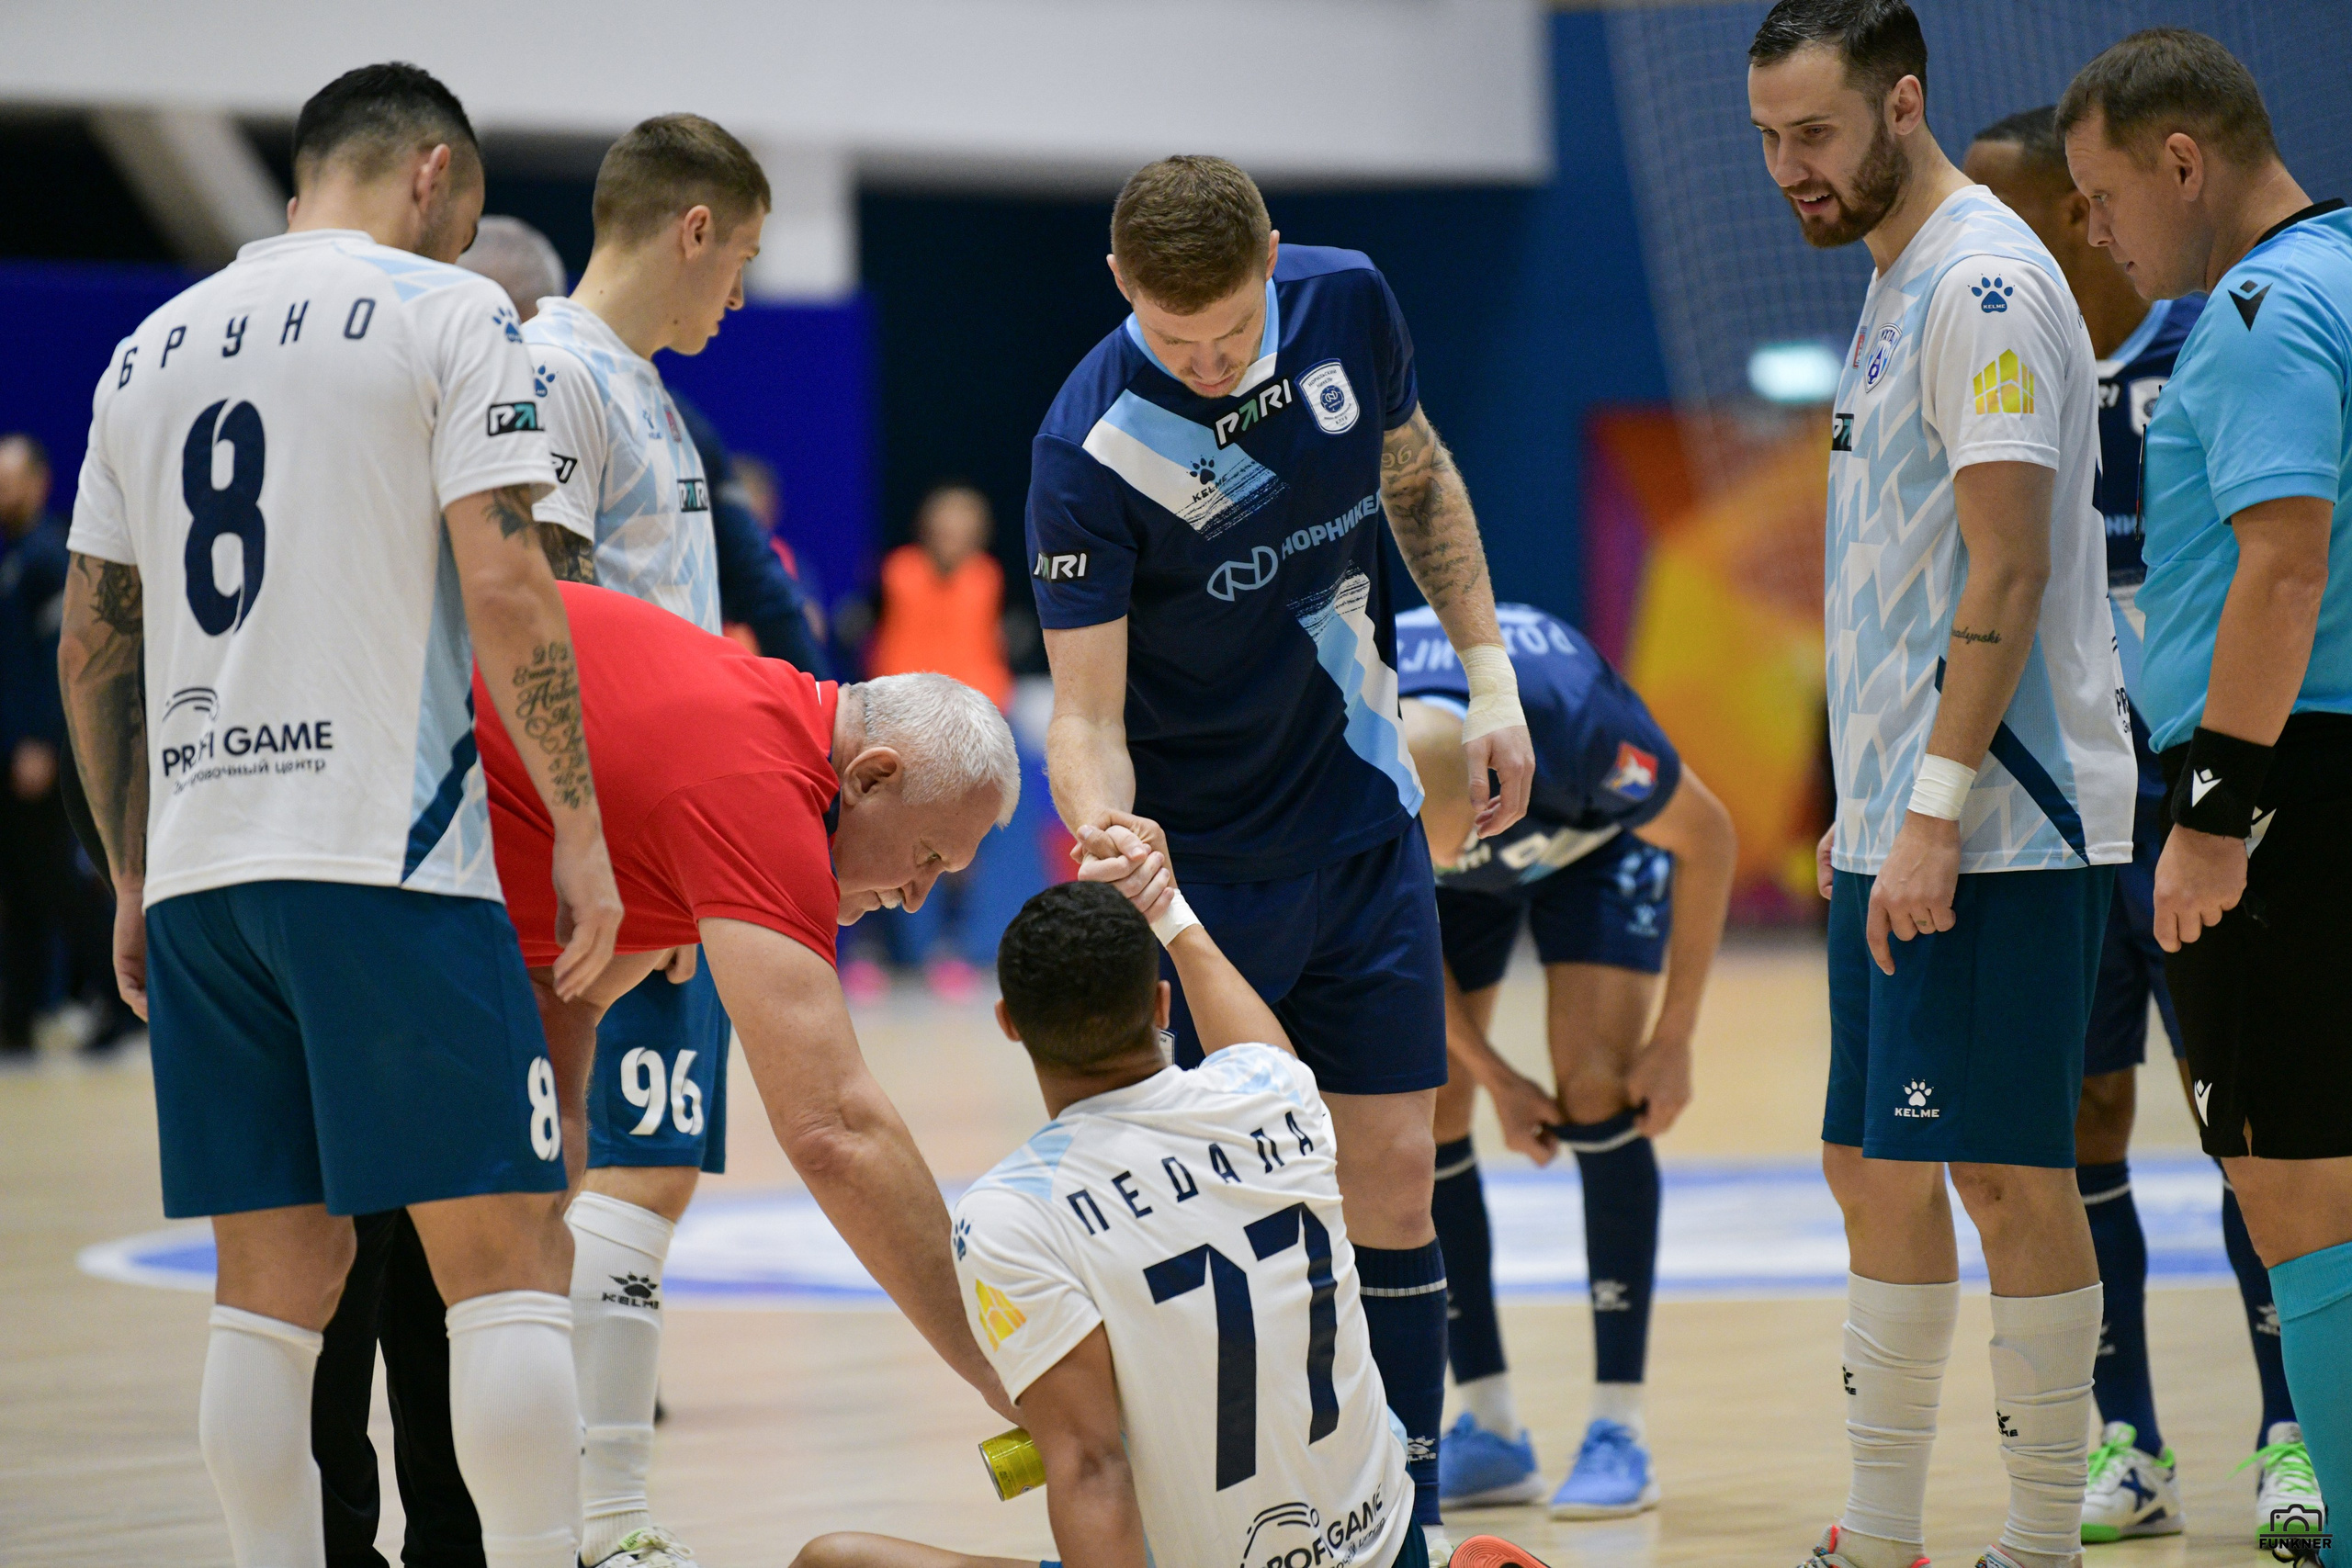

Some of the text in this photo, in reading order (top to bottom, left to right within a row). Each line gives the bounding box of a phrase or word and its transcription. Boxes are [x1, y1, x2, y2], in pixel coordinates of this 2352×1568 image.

[118, 298, 377, 390] БРУНО
[1216, 378, 1293, 446] PARI
[183, 399, 266, 636] 8
[1193, 475, 1227, 503] KELME
[223, 721, 334, 757] GAME
[527, 1056, 561, 1162] 8
[620, 1046, 705, 1136] 96
[1894, 1107, 1940, 1118] KELME
[1142, 1201, 1340, 1493] 77
